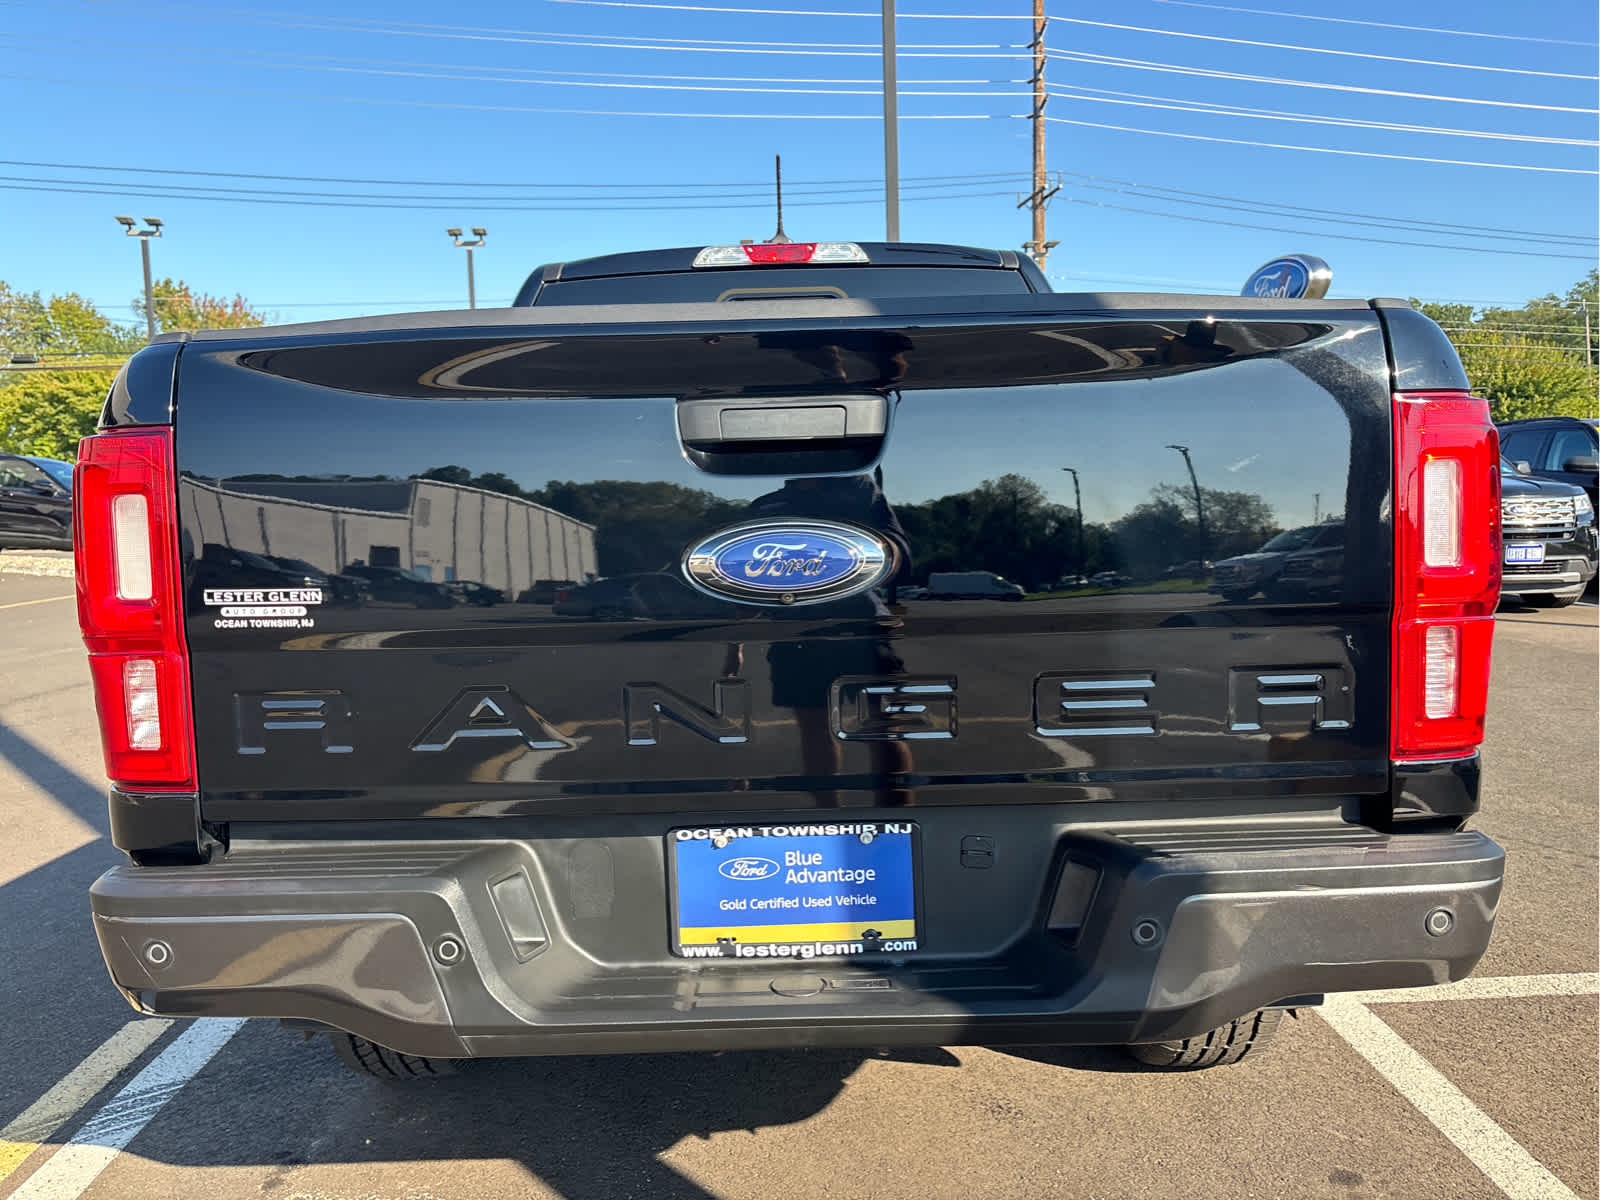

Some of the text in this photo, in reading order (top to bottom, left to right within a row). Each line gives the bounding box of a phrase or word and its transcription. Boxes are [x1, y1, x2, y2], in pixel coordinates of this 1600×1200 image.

[744, 542, 828, 578] Ford
[203, 591, 323, 602] LESTER GLENN
[225, 607, 304, 616] AUTO GROUP
[214, 619, 248, 629] OCEAN
[234, 665, 1355, 755] RANGER
[676, 827, 752, 841] OCEAN
[884, 823, 912, 835] NJ
[784, 850, 823, 867] Blue
[730, 860, 769, 878] Ford
[784, 867, 876, 885] Advantage
[719, 894, 877, 911] Gold Certified Used Vehicle
[681, 938, 917, 959] www. lesterglenn .com
